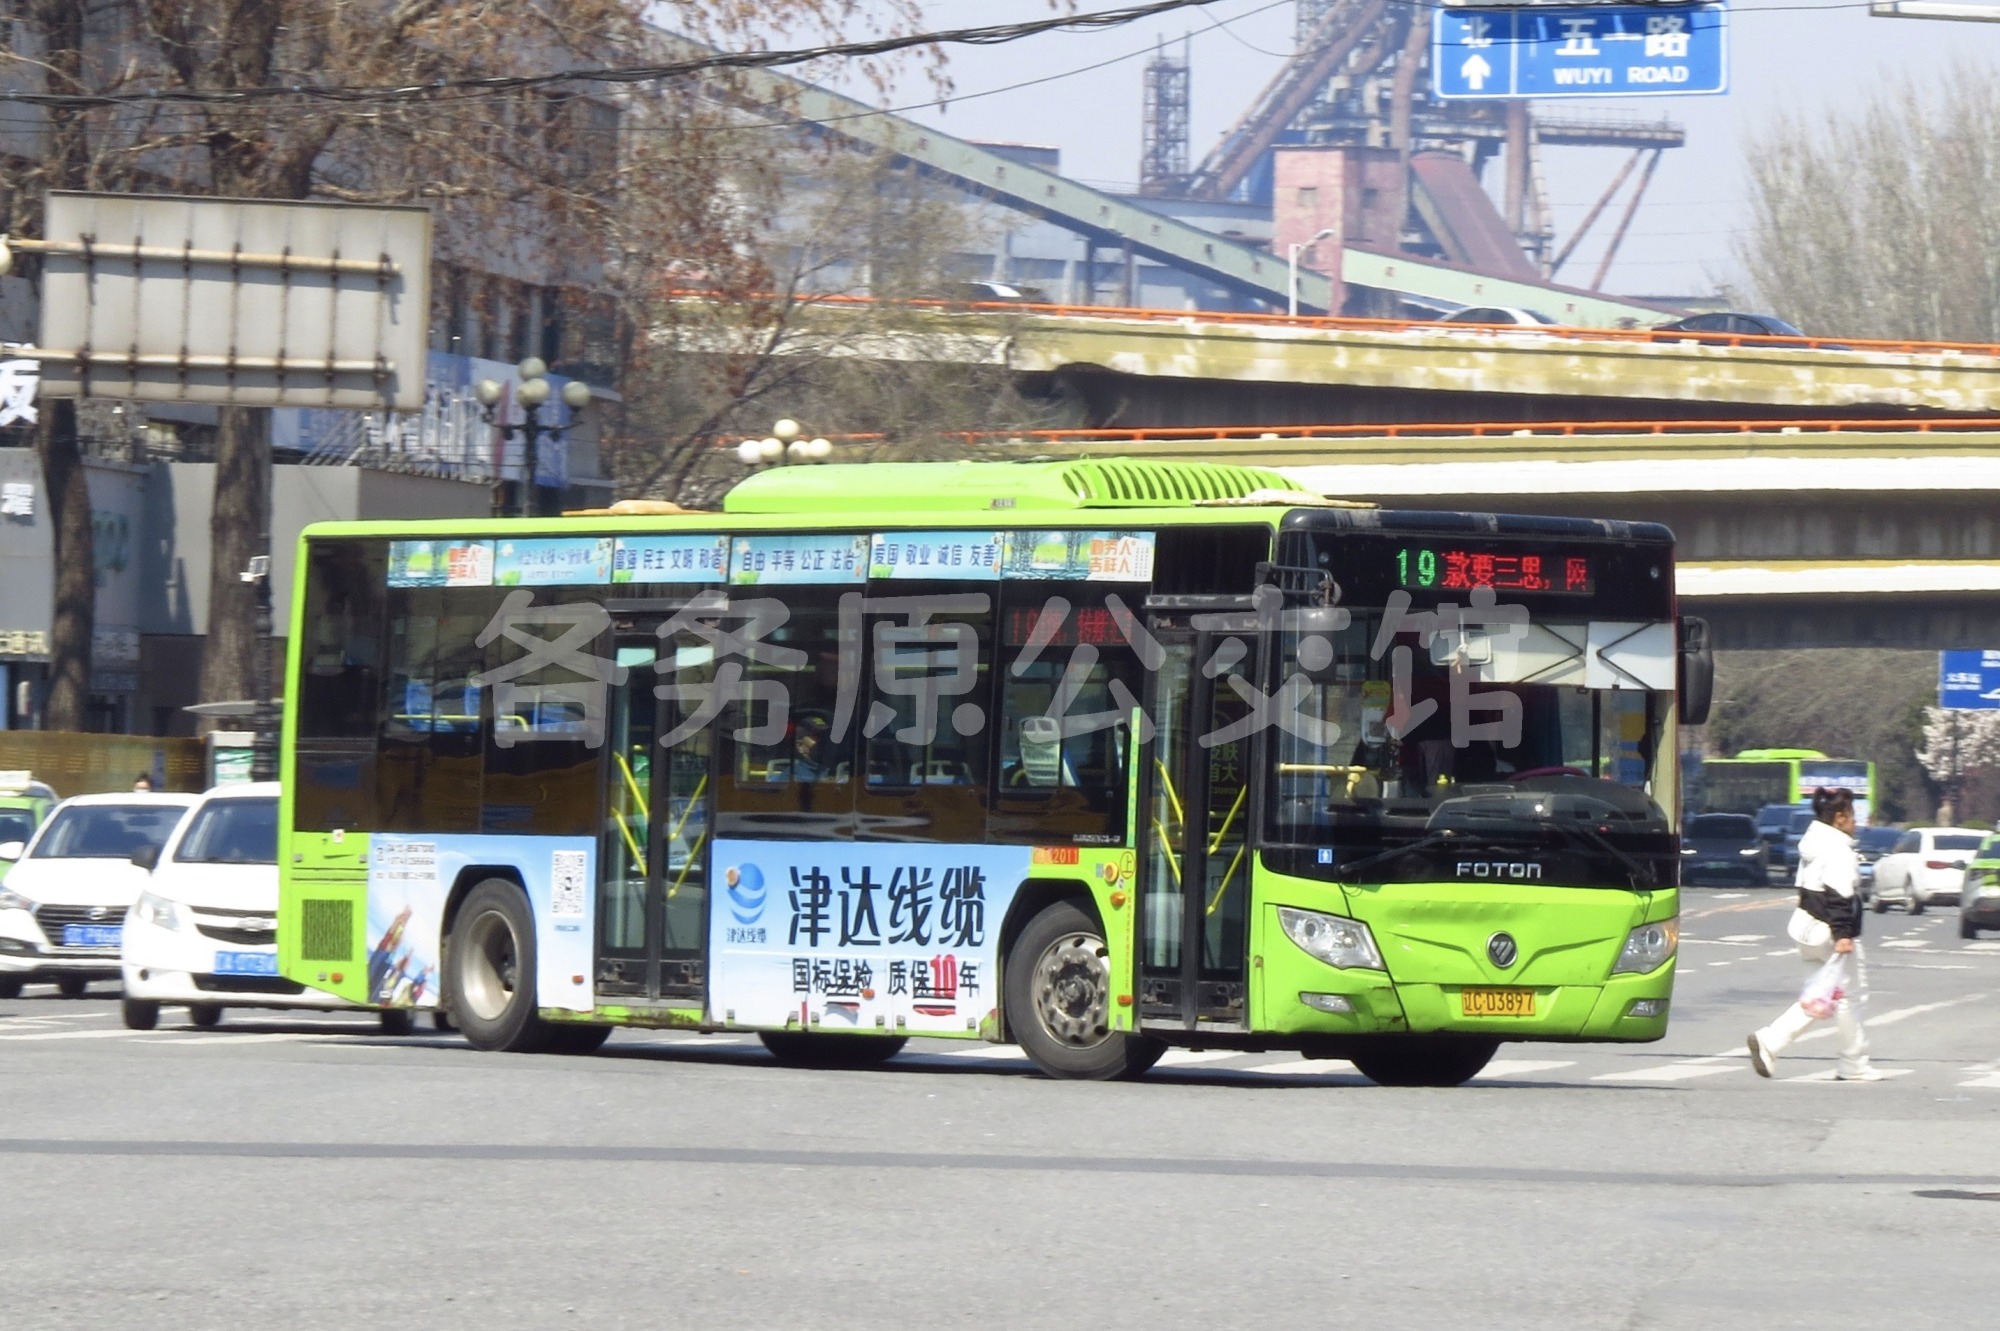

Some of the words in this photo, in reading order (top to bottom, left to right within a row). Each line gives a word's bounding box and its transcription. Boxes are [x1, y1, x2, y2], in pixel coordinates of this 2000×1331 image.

[1460, 16, 1493, 48] 北
[1555, 15, 1690, 57] 五一路
[1553, 67, 1612, 85] WUYI
[1627, 65, 1690, 84] ROAD
[615, 548, 638, 570] 富强
[643, 548, 666, 569] 民主
[670, 548, 694, 569] 文明
[699, 547, 724, 569] 和谐
[741, 550, 766, 572] 自由
[772, 548, 795, 571] 平等
[801, 548, 823, 571] 公正
[830, 547, 855, 570] 法治
[874, 543, 898, 566] 爱国
[905, 543, 930, 566] 敬业
[938, 543, 962, 566] 诚信
[969, 542, 996, 567] 友善
[1089, 557, 1131, 573] 吉祥人
[1396, 548, 1436, 586] 19
[1456, 862, 1542, 878] FOTON
[787, 866, 986, 947] 津达线缆
[887, 954, 980, 998] 质保10年
